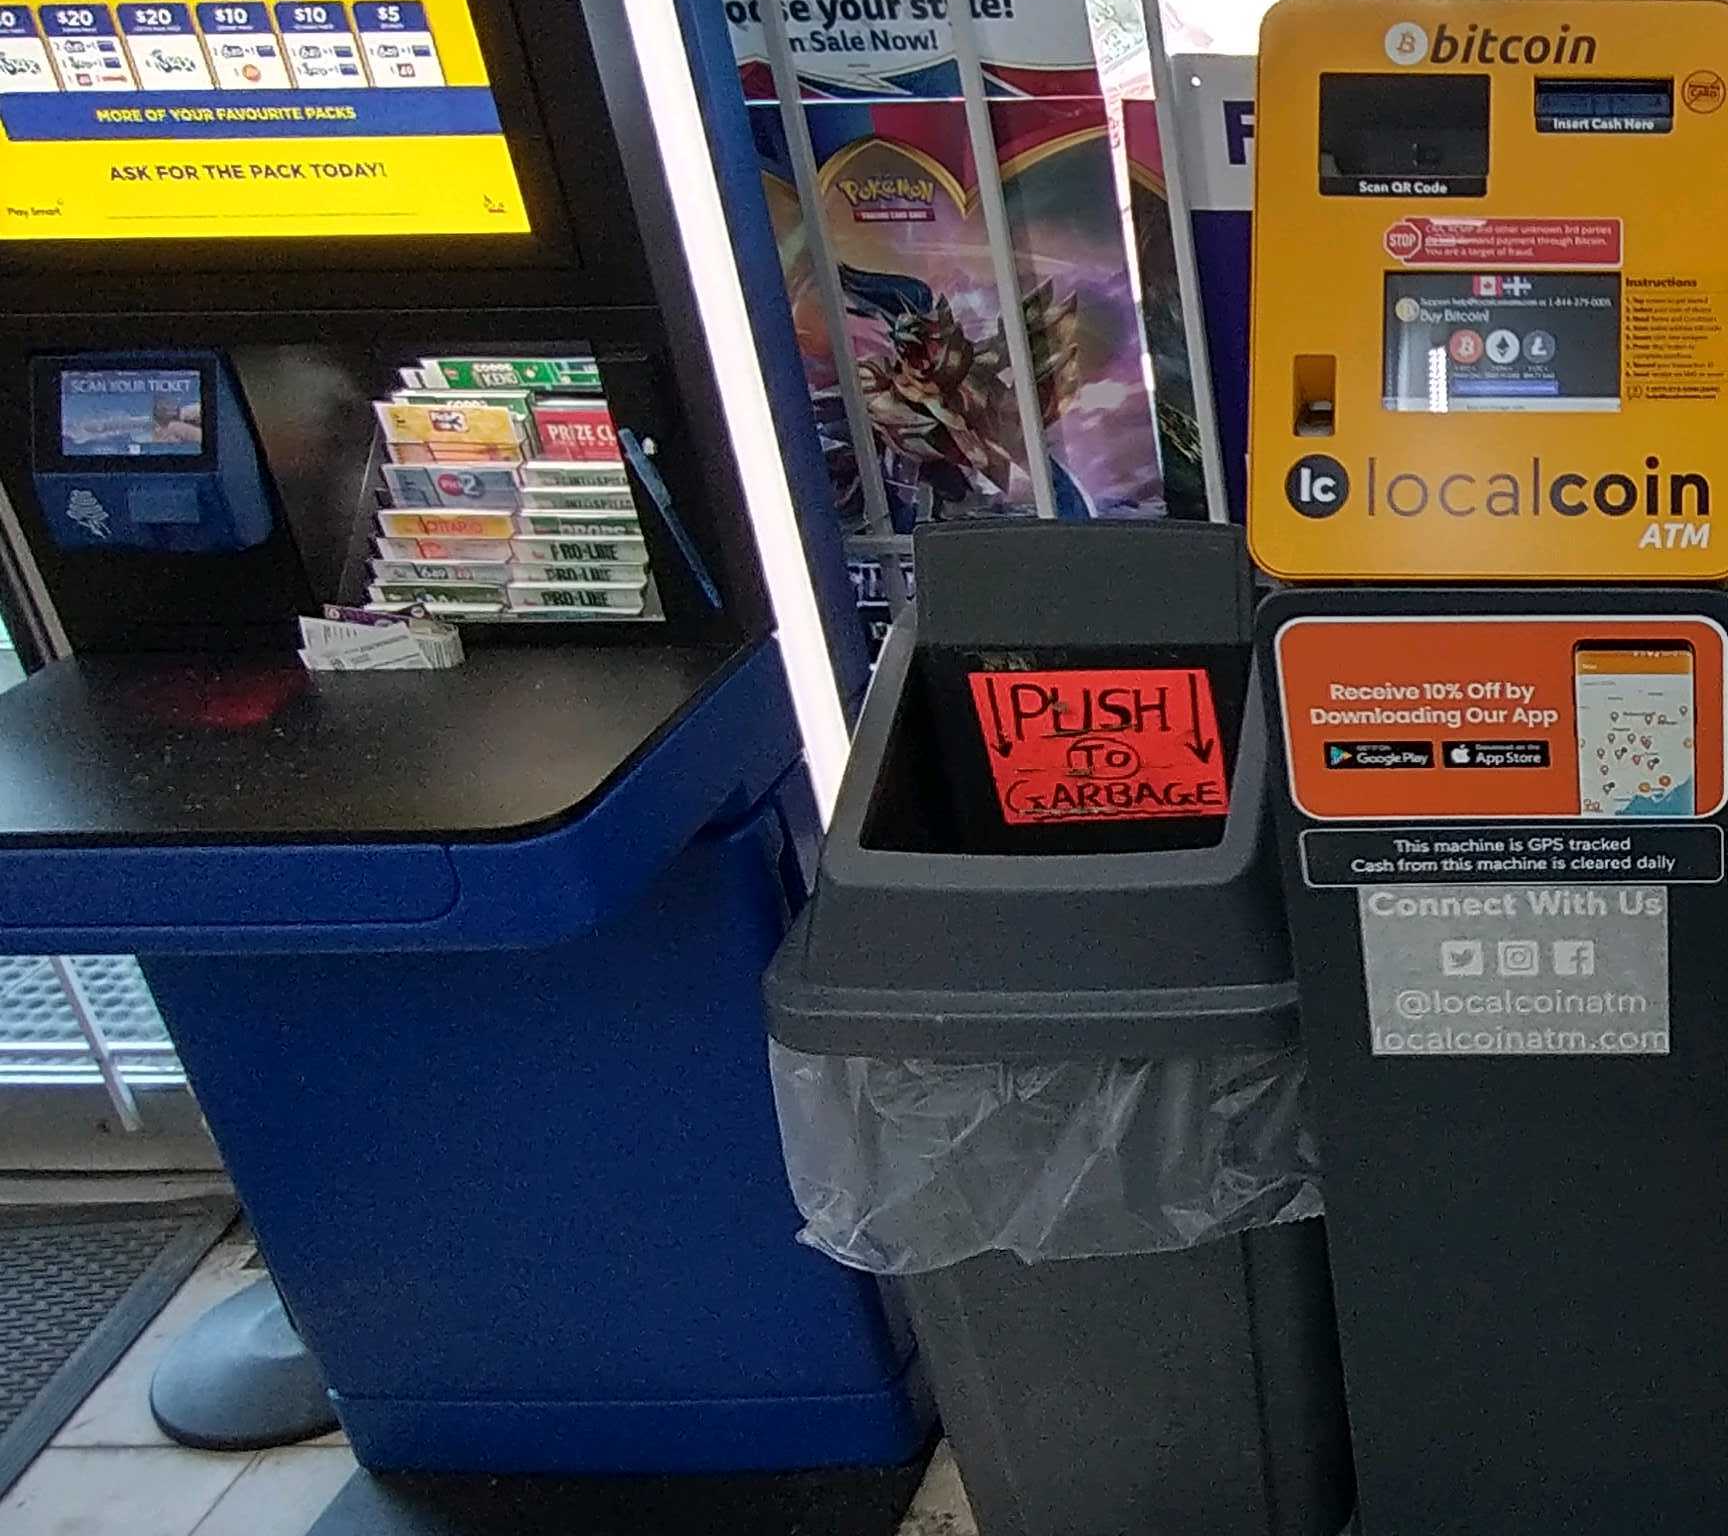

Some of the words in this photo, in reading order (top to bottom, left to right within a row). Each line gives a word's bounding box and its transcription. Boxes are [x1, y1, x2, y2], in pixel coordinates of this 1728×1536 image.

[56, 9, 94, 27] $20
[135, 8, 172, 25] $20
[214, 7, 248, 24] $10
[294, 6, 327, 23] $10
[376, 5, 400, 22] $5
[810, 28, 865, 53] Sale
[870, 27, 938, 51] Now!
[1430, 23, 1597, 65] bitcoin
[96, 108, 141, 122] MORE
[145, 109, 165, 121] OF
[170, 108, 214, 122] YOUR
[216, 107, 302, 121] FAVOURITE
[305, 106, 357, 120] PACKS
[1553, 117, 1590, 130] Insert
[1591, 117, 1622, 130] Cash
[1624, 117, 1655, 131] Here
[110, 166, 151, 181] ASK
[156, 165, 198, 180] FOR
[205, 165, 245, 180] THE
[250, 164, 305, 179] PACK
[1358, 180, 1390, 194] Scan
[1392, 180, 1412, 196] QR
[1414, 180, 1448, 195] Code
[1495, 224, 1519, 234] other
[1520, 225, 1563, 234] unknown
[1564, 224, 1579, 234] 3rd
[1580, 225, 1613, 236] parties
[1388, 235, 1416, 248] STOP
[1496, 237, 1535, 248] payment
[1537, 236, 1573, 248] through
[1574, 235, 1608, 246] Bitcoin.
[1425, 247, 1440, 256] You
[1441, 248, 1459, 256] are
[1468, 247, 1495, 258] target
[1508, 246, 1535, 257] fraud.
[1625, 277, 1698, 288] Instructions
[1420, 309, 1442, 324] Buy
[70, 379, 107, 393] SCAN
[109, 379, 147, 393] YOUR
[148, 379, 192, 393] TICKET
[547, 424, 593, 442] PRIZE
[1301, 468, 1337, 504] lc
[1366, 455, 1711, 518] localcoin
[1638, 522, 1711, 549] ATM
[551, 542, 619, 560] PRO-LINE
[1329, 681, 1420, 701] Receive
[1422, 682, 1463, 700] 10%
[1467, 682, 1501, 700] Off
[1505, 681, 1536, 704] by
[1009, 682, 1172, 741] PUSH
[1310, 705, 1462, 729] Downloading
[1465, 706, 1508, 724] Our
[1511, 706, 1559, 728] App
[1076, 741, 1132, 769] TO
[1357, 752, 1402, 766] Google
[1402, 751, 1428, 767] Play
[1475, 752, 1503, 766] App
[1505, 752, 1542, 765] Store
[1004, 779, 1223, 815] GARBAGE
[1393, 838, 1429, 853] This
[1432, 838, 1505, 853] machine
[1509, 838, 1523, 852] is
[1527, 837, 1564, 852] GPS
[1568, 837, 1631, 852] tracked
[1350, 857, 1395, 873] Cash
[1397, 857, 1438, 872] from
[1440, 856, 1473, 871] this
[1476, 856, 1548, 871] machine
[1551, 855, 1566, 870] is
[1570, 855, 1632, 870] cleared
[1636, 855, 1676, 873] daily
[1368, 890, 1518, 916] Connect
[1527, 889, 1608, 915] With
[1618, 889, 1664, 916] Us
[1396, 988, 1648, 1020] @localcoinatm
[1373, 1024, 1670, 1052] localcoinatm.com
